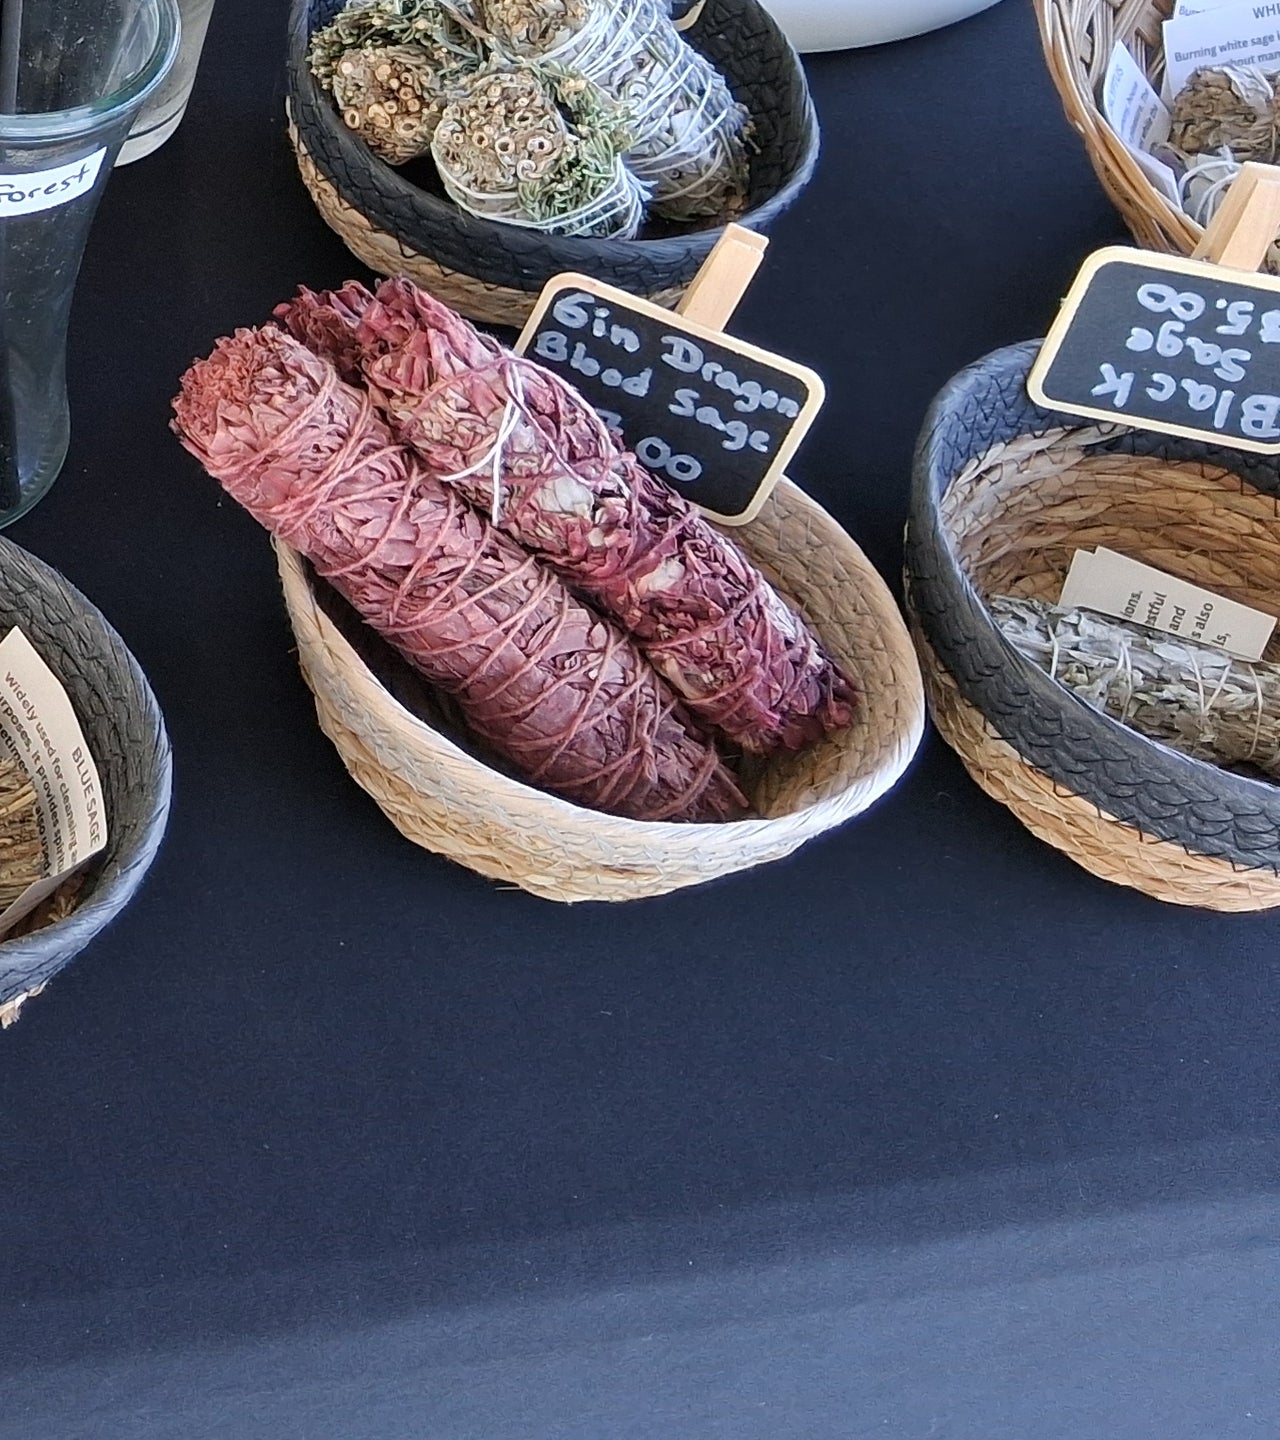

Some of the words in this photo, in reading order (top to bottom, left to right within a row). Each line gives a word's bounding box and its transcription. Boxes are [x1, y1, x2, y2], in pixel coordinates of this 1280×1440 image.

[1174, 45, 1218, 63] Burning
[1218, 39, 1249, 53] white
[1250, 33, 1275, 47] sage
[660, 335, 800, 419] Dragon
[1125, 320, 1253, 382] Sage
[534, 330, 654, 398] Blood
[668, 388, 771, 454] Sage
[1090, 362, 1280, 438] Black
[1168, 604, 1187, 632] and
[1194, 601, 1215, 631] also
[4, 669, 39, 721] Widely
[35, 720, 57, 760] used
[51, 756, 65, 783] for
[58, 781, 80, 853] cleansing
[34, 766, 60, 829] provides
[71, 745, 96, 799] BLUE
[85, 795, 102, 849] SAGE
